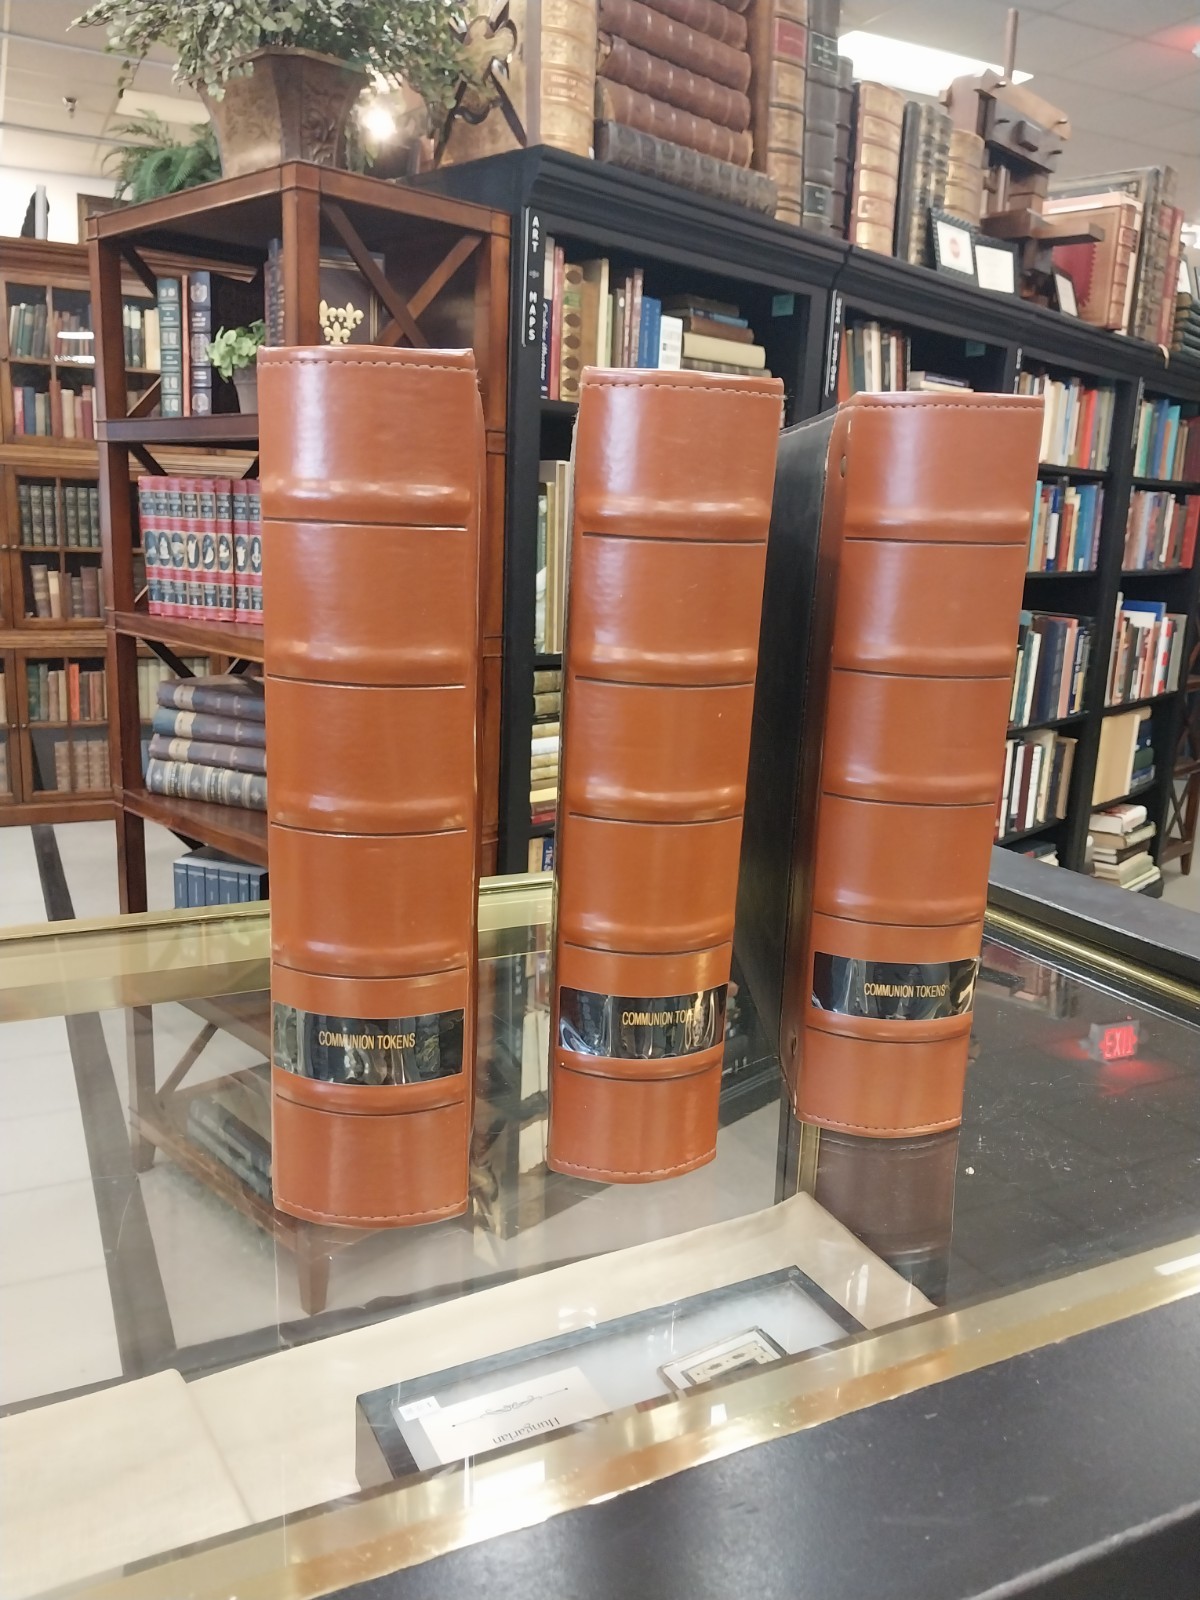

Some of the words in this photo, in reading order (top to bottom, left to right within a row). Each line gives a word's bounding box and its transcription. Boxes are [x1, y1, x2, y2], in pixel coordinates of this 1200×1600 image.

[531, 215, 540, 253] ART
[528, 290, 538, 341] MAPS
[863, 982, 914, 998] COMMUNION
[916, 984, 946, 998] TOKENS
[622, 1010, 674, 1026] COMMUNION
[318, 1030, 375, 1050] COMMUNION
[377, 1032, 416, 1050] TOKENS
[492, 1417, 560, 1444] Hungarian
